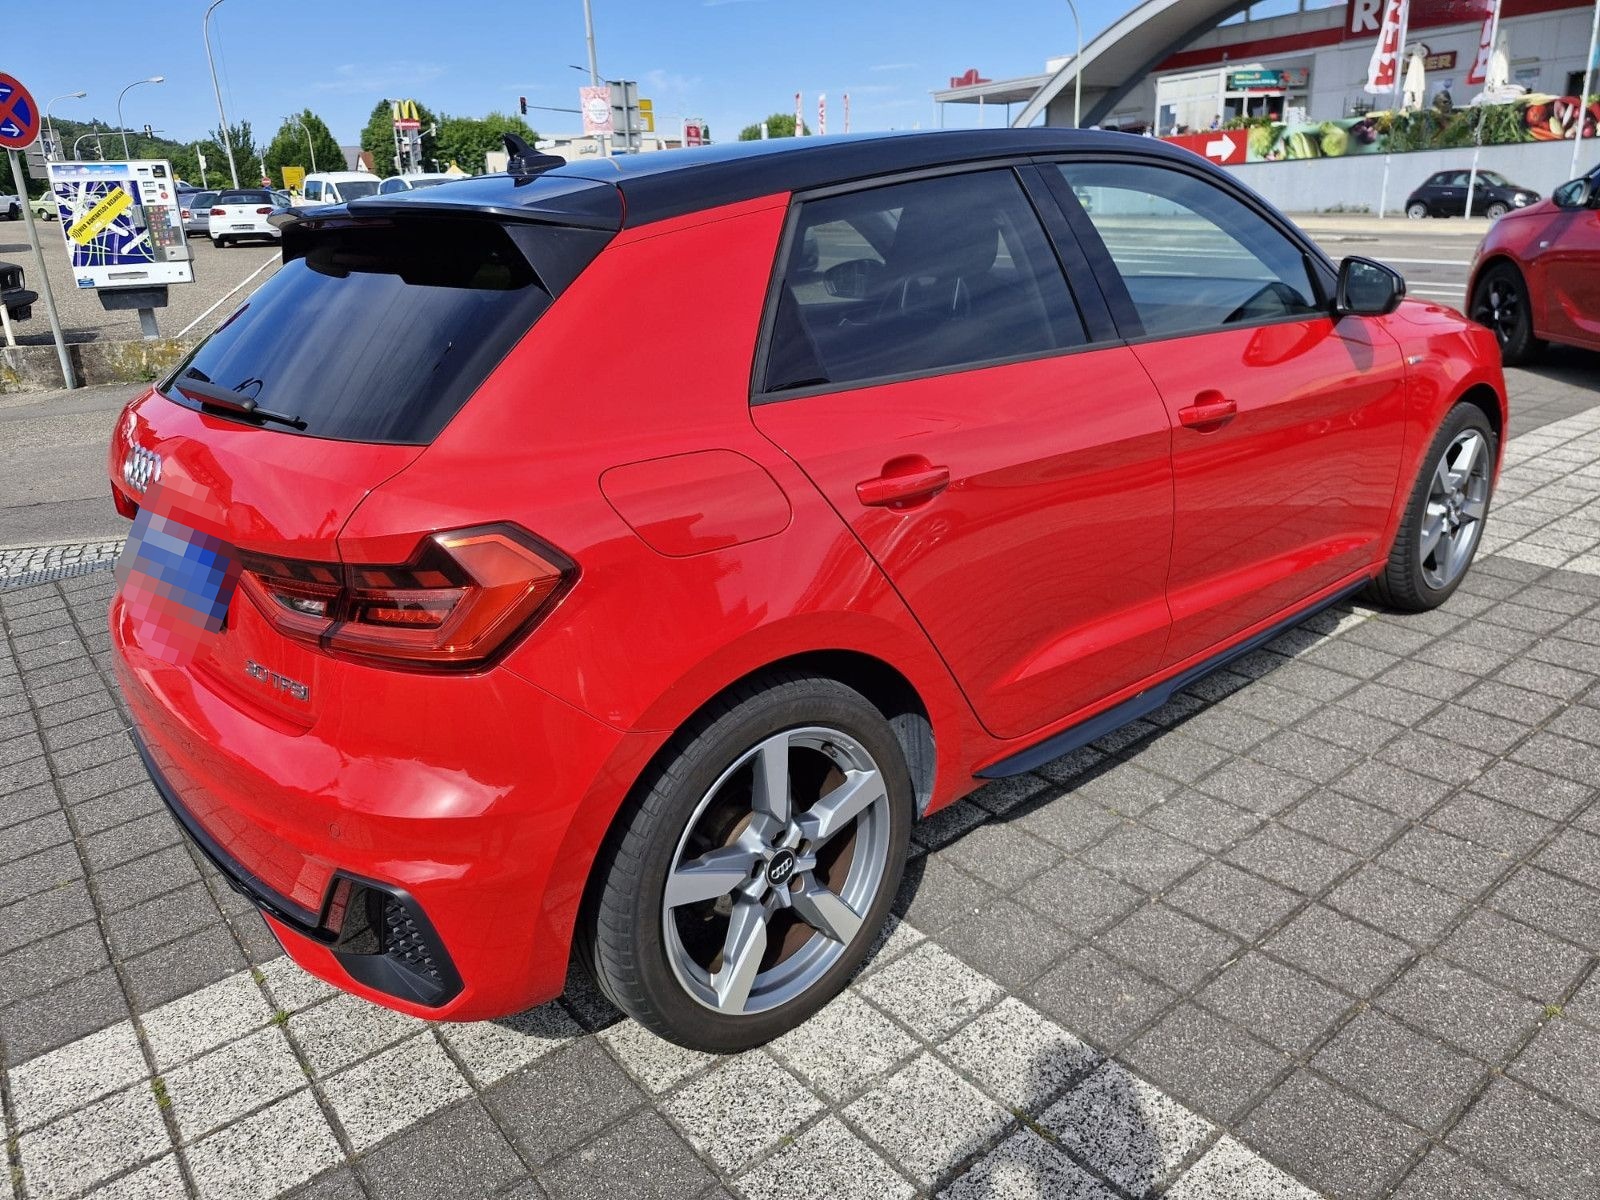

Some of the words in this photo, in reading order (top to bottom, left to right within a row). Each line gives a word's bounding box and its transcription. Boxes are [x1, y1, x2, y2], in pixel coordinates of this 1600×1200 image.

[87, 204, 108, 225] KONTAKTLOS
[107, 191, 124, 206] BEZAHLEN
[271, 673, 309, 702] TFSI
